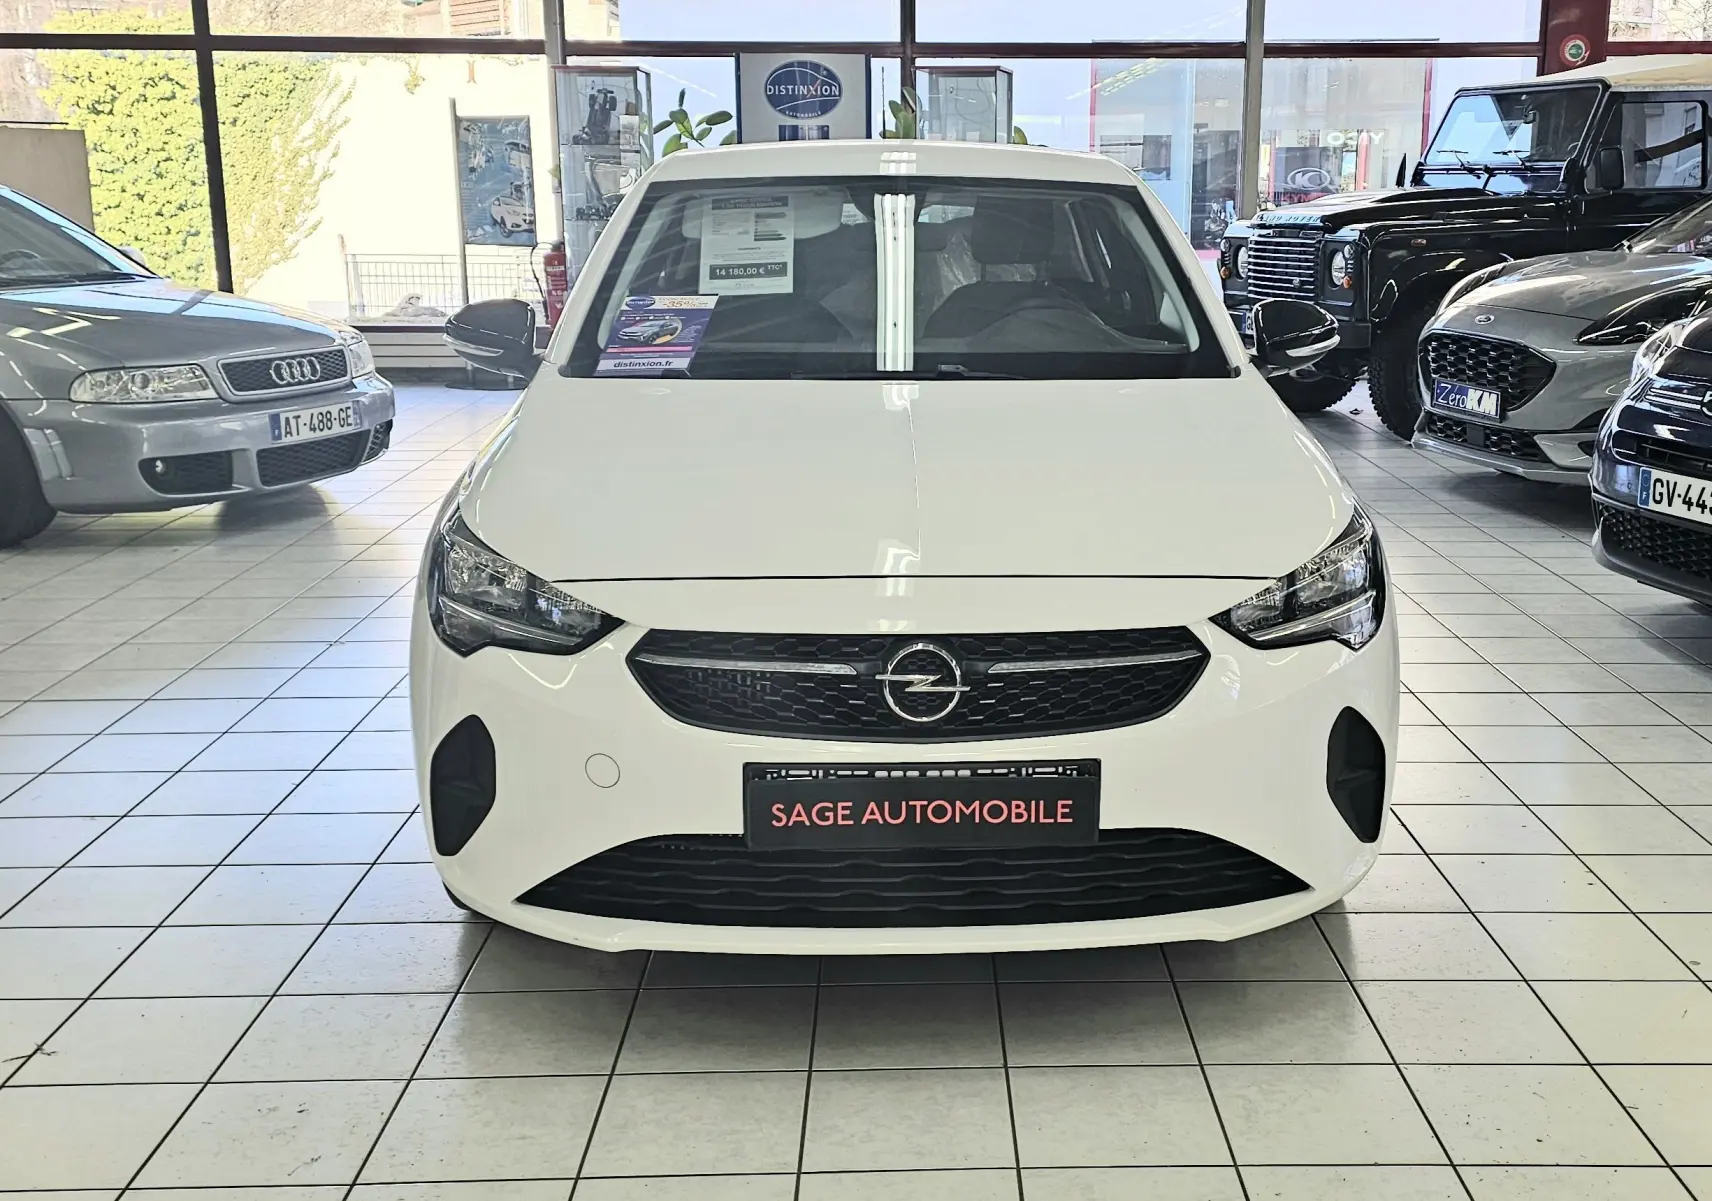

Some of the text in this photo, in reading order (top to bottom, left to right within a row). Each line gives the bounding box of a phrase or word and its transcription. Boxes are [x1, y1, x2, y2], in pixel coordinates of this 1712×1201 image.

[767, 82, 839, 97] DISTINXION
[715, 268, 726, 276] 14
[728, 267, 758, 276] 180,00
[613, 360, 673, 368] distinxion.fr
[284, 407, 352, 438] AT-488-GE
[771, 800, 1073, 827] SAGE AUTOMOBILE
